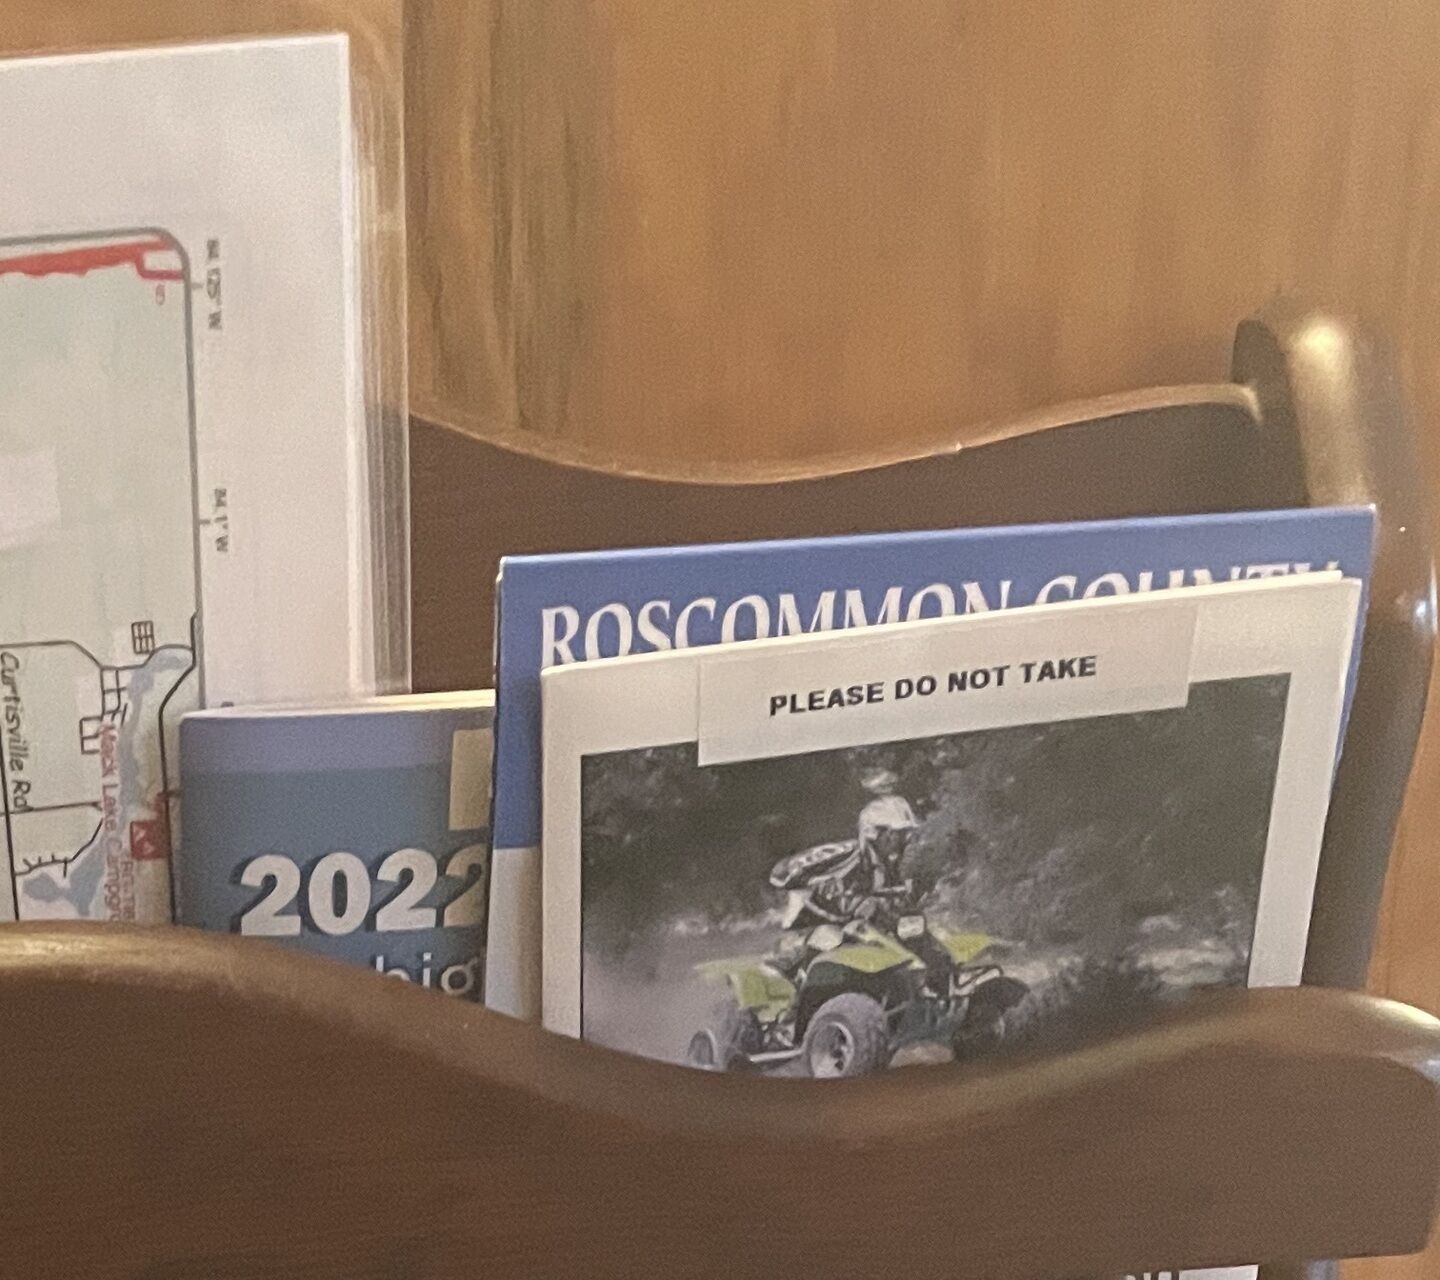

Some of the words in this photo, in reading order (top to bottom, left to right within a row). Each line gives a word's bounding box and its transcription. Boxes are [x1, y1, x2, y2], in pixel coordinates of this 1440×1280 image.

[0, 651, 32, 774] Curtisville
[769, 681, 885, 718] PLEASE
[894, 676, 938, 702] DO
[946, 665, 1011, 694] NOT
[1018, 654, 1099, 686] TAKE
[12, 780, 35, 813] Rd
[240, 848, 489, 937] 2022
